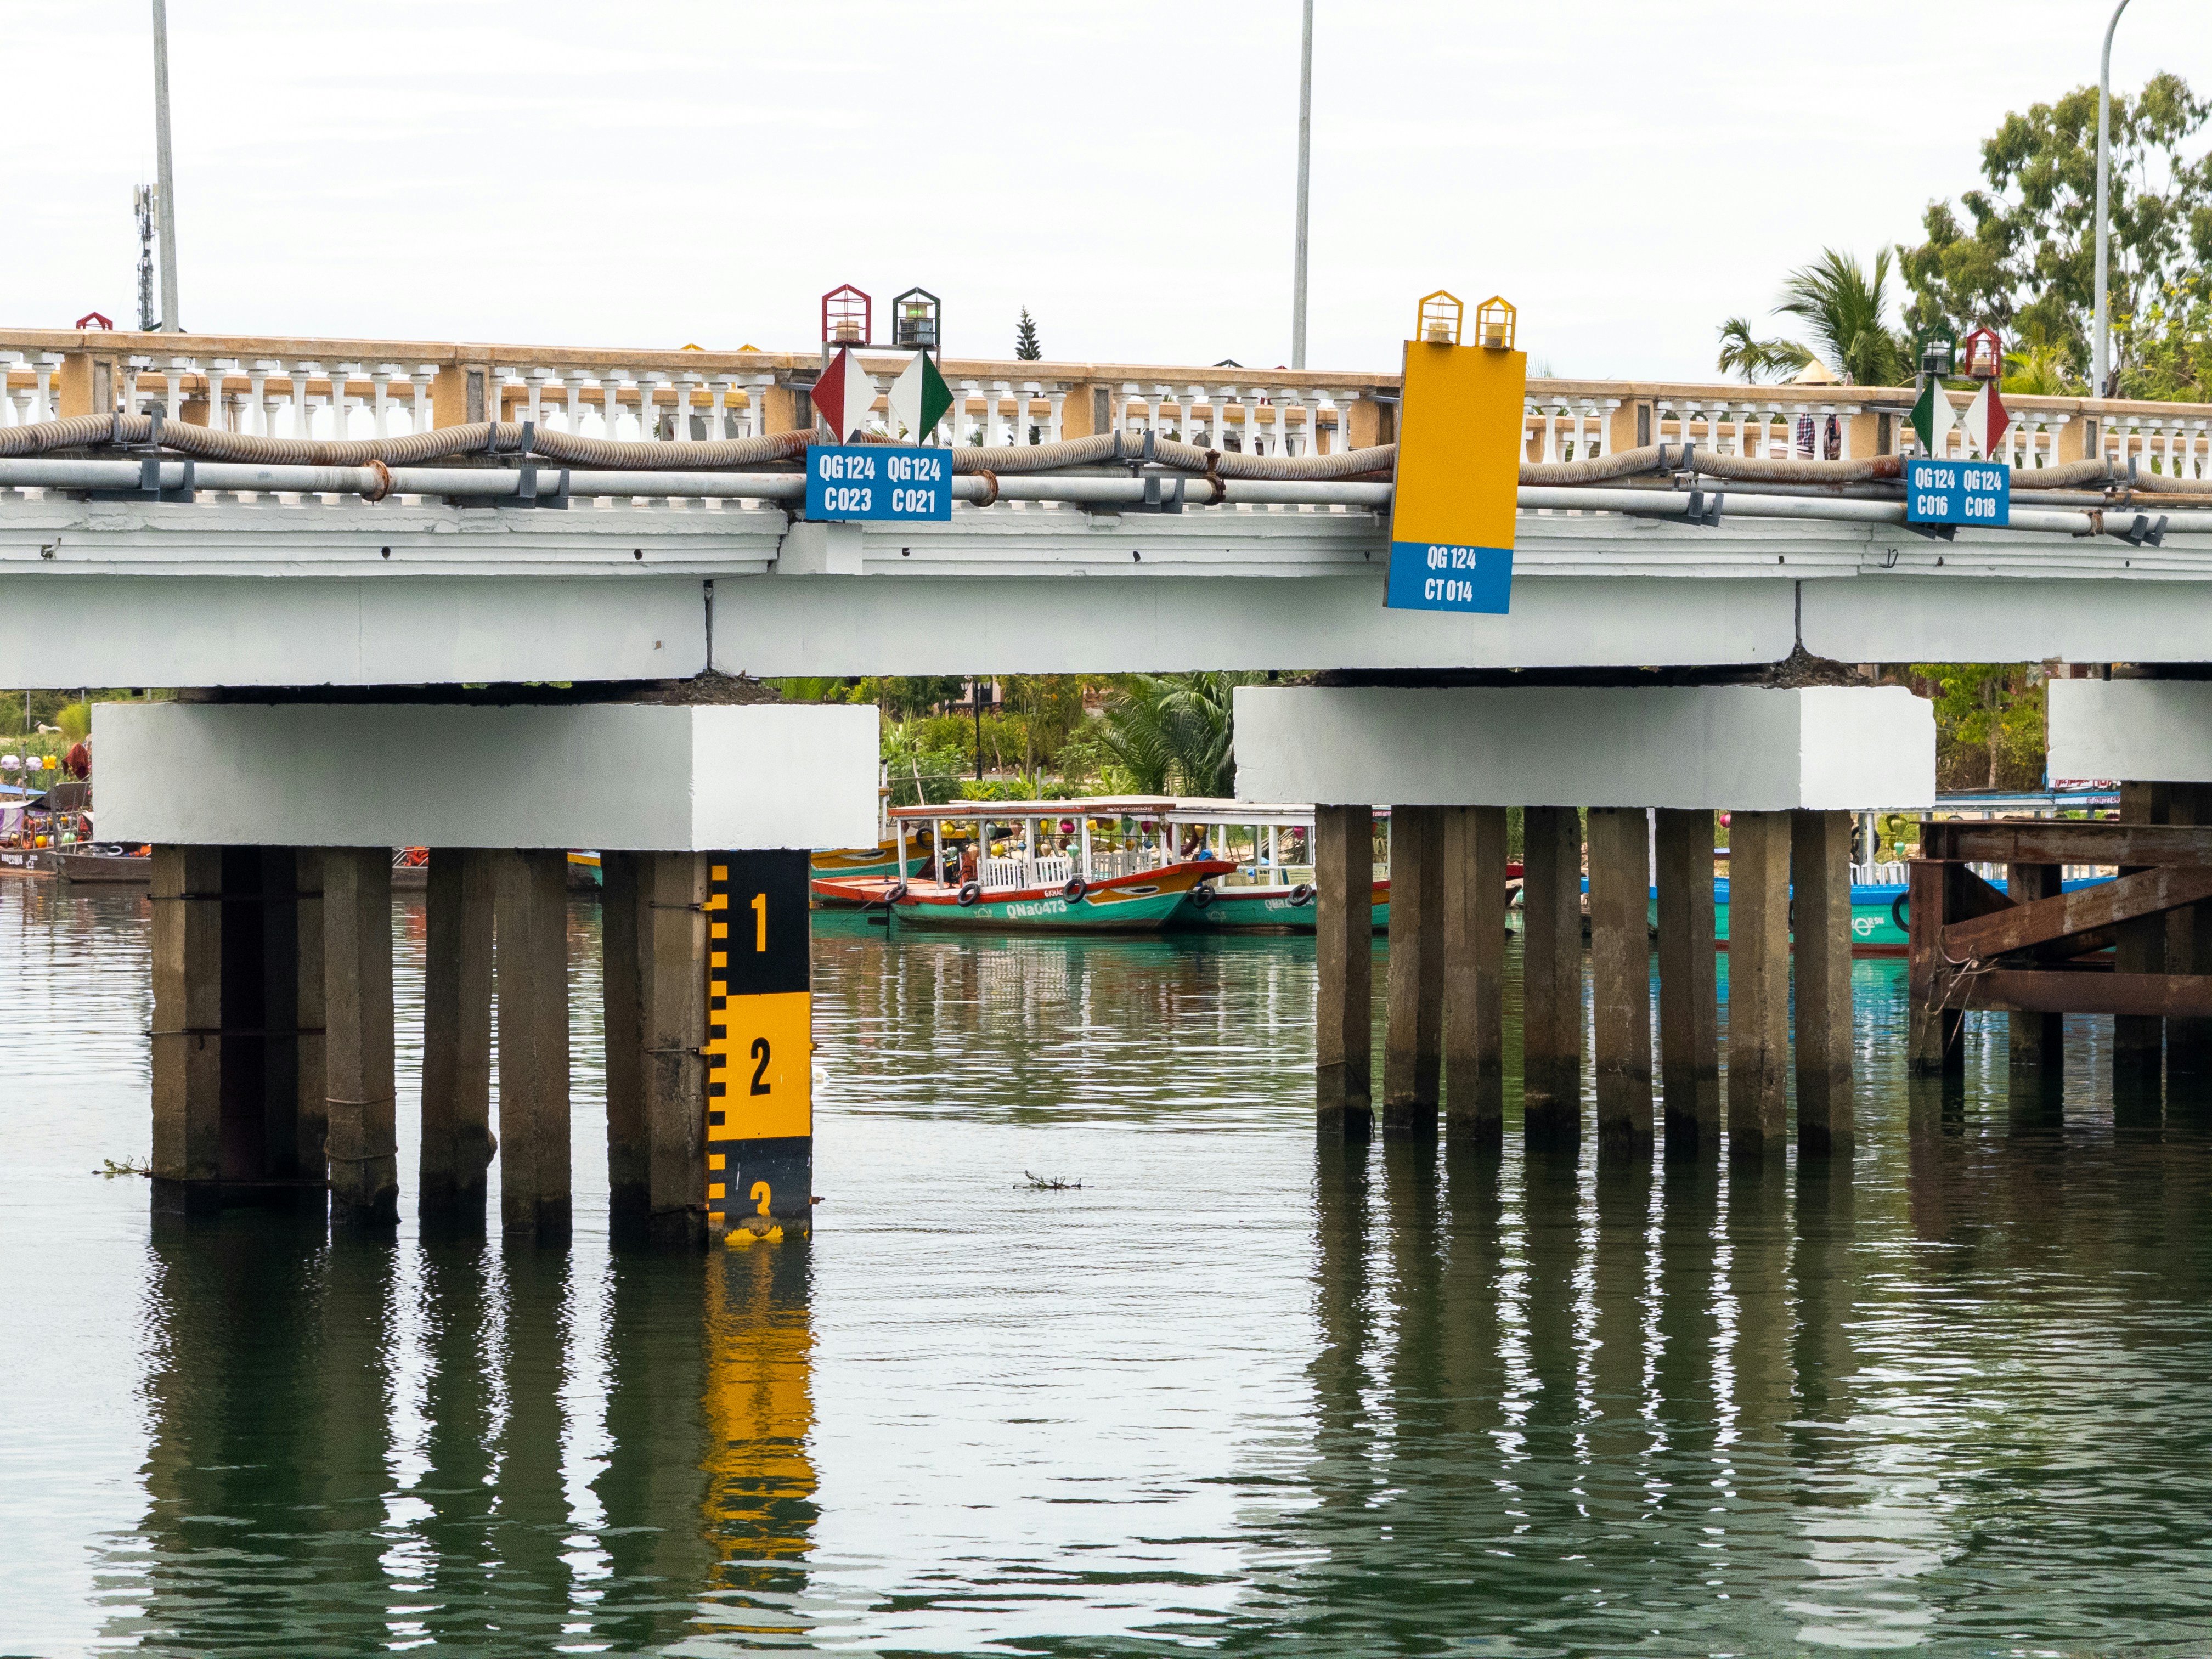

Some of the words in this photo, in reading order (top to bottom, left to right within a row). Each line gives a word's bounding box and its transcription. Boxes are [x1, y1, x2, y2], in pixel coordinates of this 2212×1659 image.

[819, 455, 875, 482] QG124
[888, 456, 941, 482] QG124
[1915, 467, 1955, 489] QG124
[1963, 470, 2002, 492] QG124
[825, 487, 872, 511] C023
[892, 488, 935, 512] C021
[1917, 495, 1948, 516] C016
[1965, 496, 1995, 517] C018
[751, 893, 766, 952] 1
[1006, 900, 1066, 919] QNa0473
[750, 1037, 771, 1096] 2
[750, 1181, 771, 1217] 3
